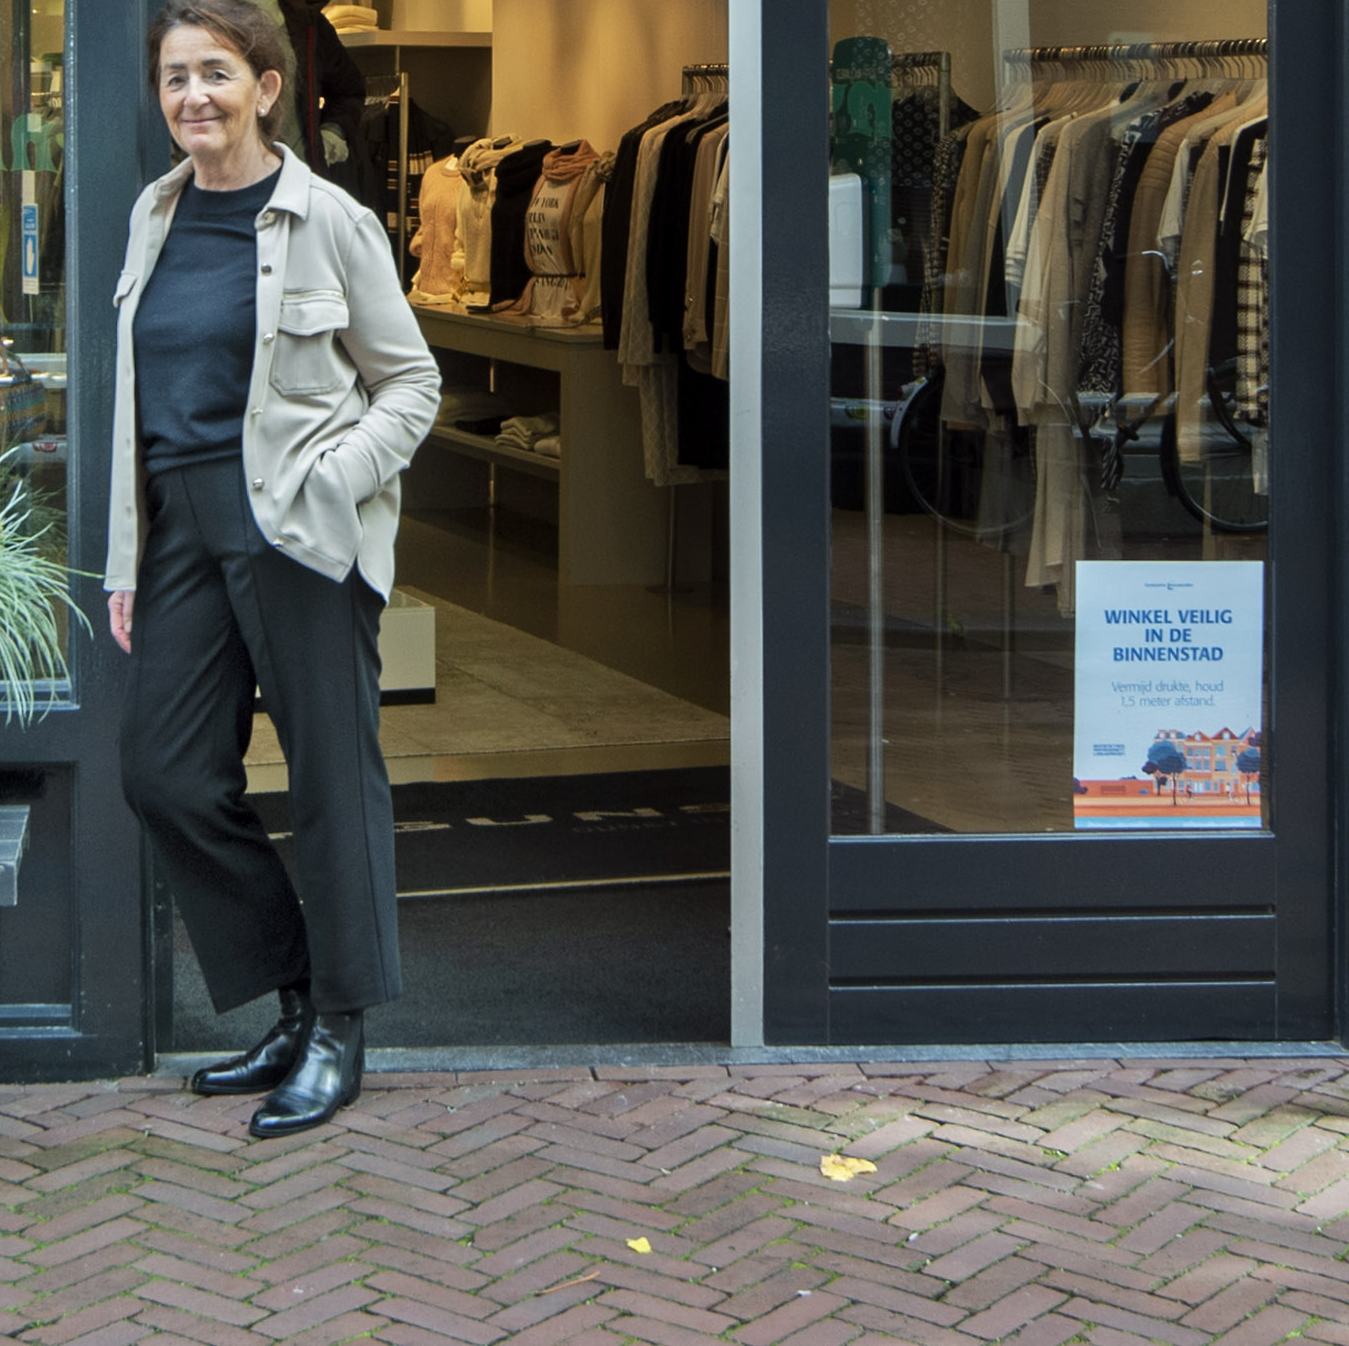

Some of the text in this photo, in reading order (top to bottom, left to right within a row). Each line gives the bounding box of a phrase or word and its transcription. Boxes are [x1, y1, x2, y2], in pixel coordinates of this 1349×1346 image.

[1104, 609, 1233, 624] WINKEL VEILIG
[1145, 628, 1192, 643] IN DE
[1113, 646, 1224, 662] BINNENSTAD
[1111, 680, 1224, 695] Vermijd drukte, houd
[1139, 697, 1171, 707] meter
[1174, 694, 1217, 707] afstand.
